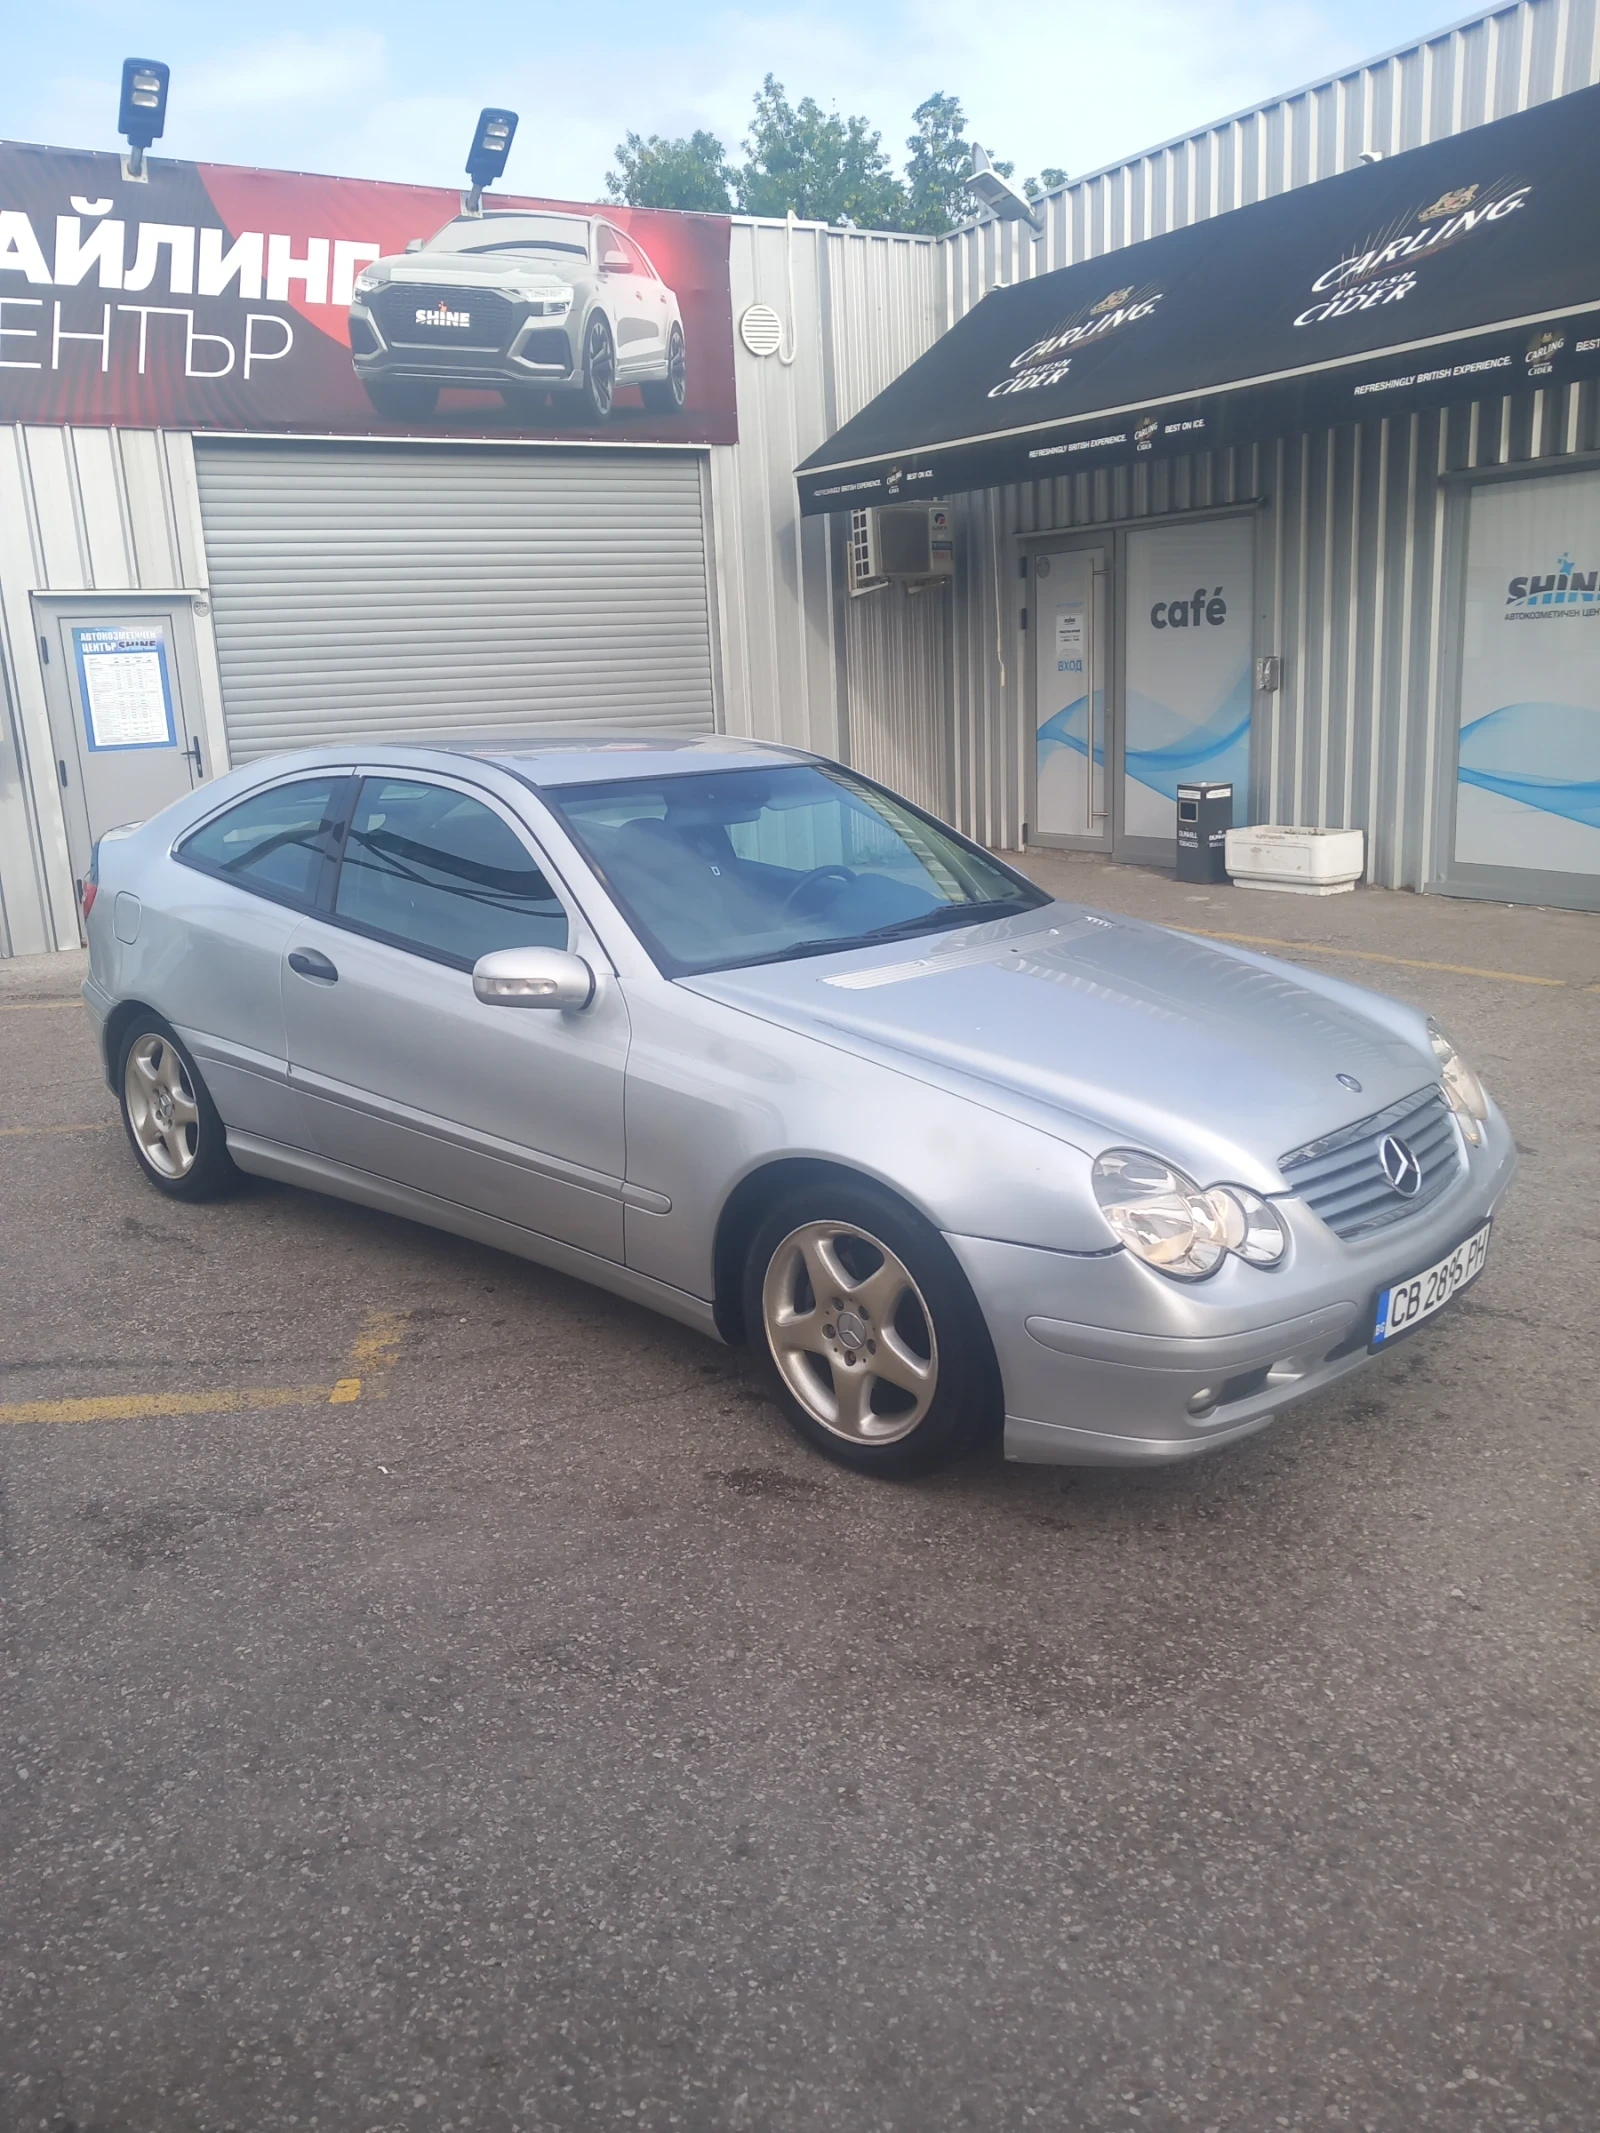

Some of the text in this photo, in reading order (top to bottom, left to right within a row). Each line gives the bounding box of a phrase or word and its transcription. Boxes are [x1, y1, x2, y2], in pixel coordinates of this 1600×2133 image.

[1330, 271, 1417, 302] BRITISH
[1293, 281, 1418, 327] CIDER
[415, 309, 470, 328] SHINE
[1525, 338, 1564, 362] CARLING
[1015, 358, 1073, 378] BRITISH
[1354, 356, 1512, 395] REFRESHINGLY BRITISH EXPERIENCE.
[1527, 365, 1553, 376] CIDER
[987, 367, 1070, 398] CIDER
[1134, 421, 1159, 440] CARLING
[1164, 423, 1181, 433] BEST
[1181, 421, 1192, 431] ON
[1028, 445, 1068, 458] REFRESHINGLY
[1068, 440, 1090, 452] BRITISH
[1505, 571, 1600, 606] SHIN
[1150, 586, 1227, 629] café
[1504, 609, 1580, 620] АВТОКОЗМЕТИЧЕН
[81, 642, 117, 653] ЦЕНТЪР
[1058, 660, 1082, 673] ВХОД
[1391, 1281, 1421, 1328] CB
[1466, 1228, 1488, 1278] PH
[1375, 1322, 1386, 1336] BG
